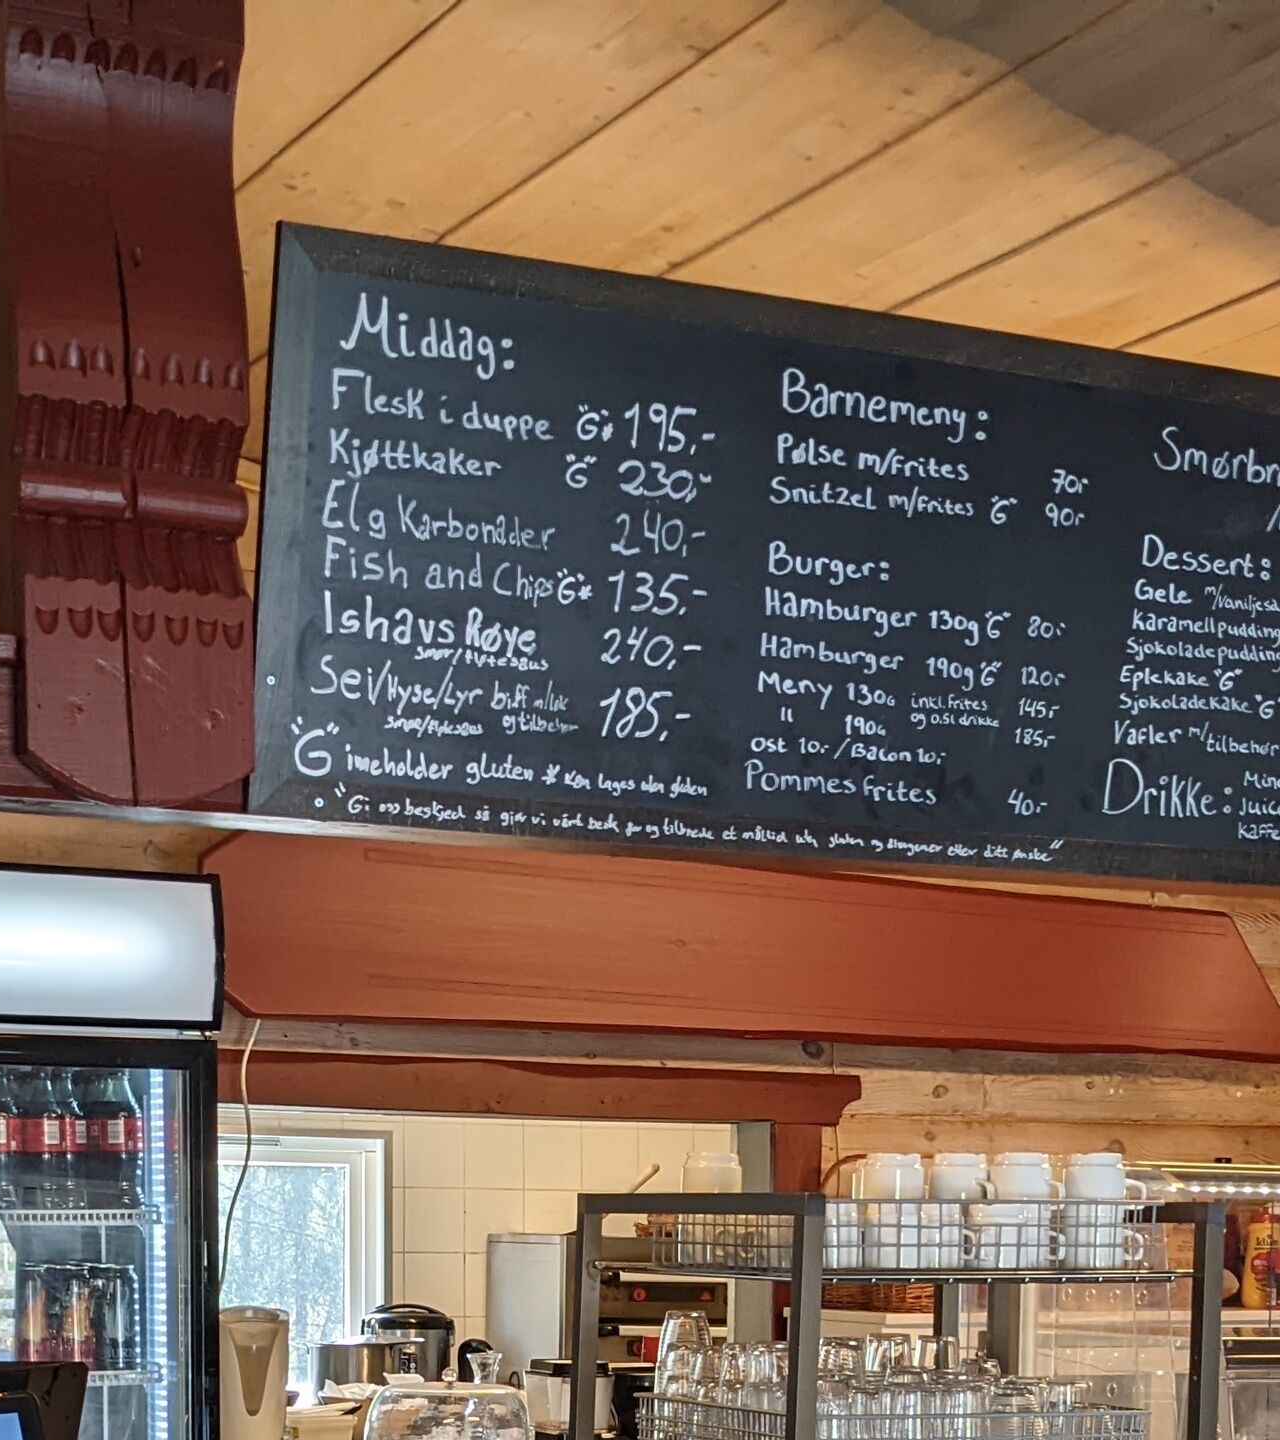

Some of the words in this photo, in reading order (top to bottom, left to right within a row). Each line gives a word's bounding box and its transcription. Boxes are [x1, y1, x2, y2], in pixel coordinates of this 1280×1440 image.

[340, 292, 516, 380] Middag:
[331, 367, 425, 422] Flesk
[462, 405, 555, 441] duppe
[624, 402, 716, 456] 195,-
[330, 428, 503, 479] Kjøttkaker
[769, 476, 876, 511] Snitzel
[321, 479, 387, 540] Elg
[610, 509, 706, 557] 240,-
[324, 537, 408, 590] Fish
[424, 551, 483, 590] and
[608, 569, 708, 615] 135,-
[768, 540, 891, 586] Burger:
[1141, 534, 1272, 582] Dessert:
[764, 586, 918, 638] Hamburger
[1134, 578, 1193, 604] Gele
[324, 590, 454, 645] Ishavs
[600, 625, 703, 671] 240,-
[759, 632, 905, 675] Hamburger
[756, 670, 834, 711] Meny
[1119, 665, 1210, 692] Eplekake
[600, 686, 692, 744] 185,-
[910, 712, 927, 730] og
[465, 752, 535, 785] gluten
[744, 758, 857, 795] Pommes
